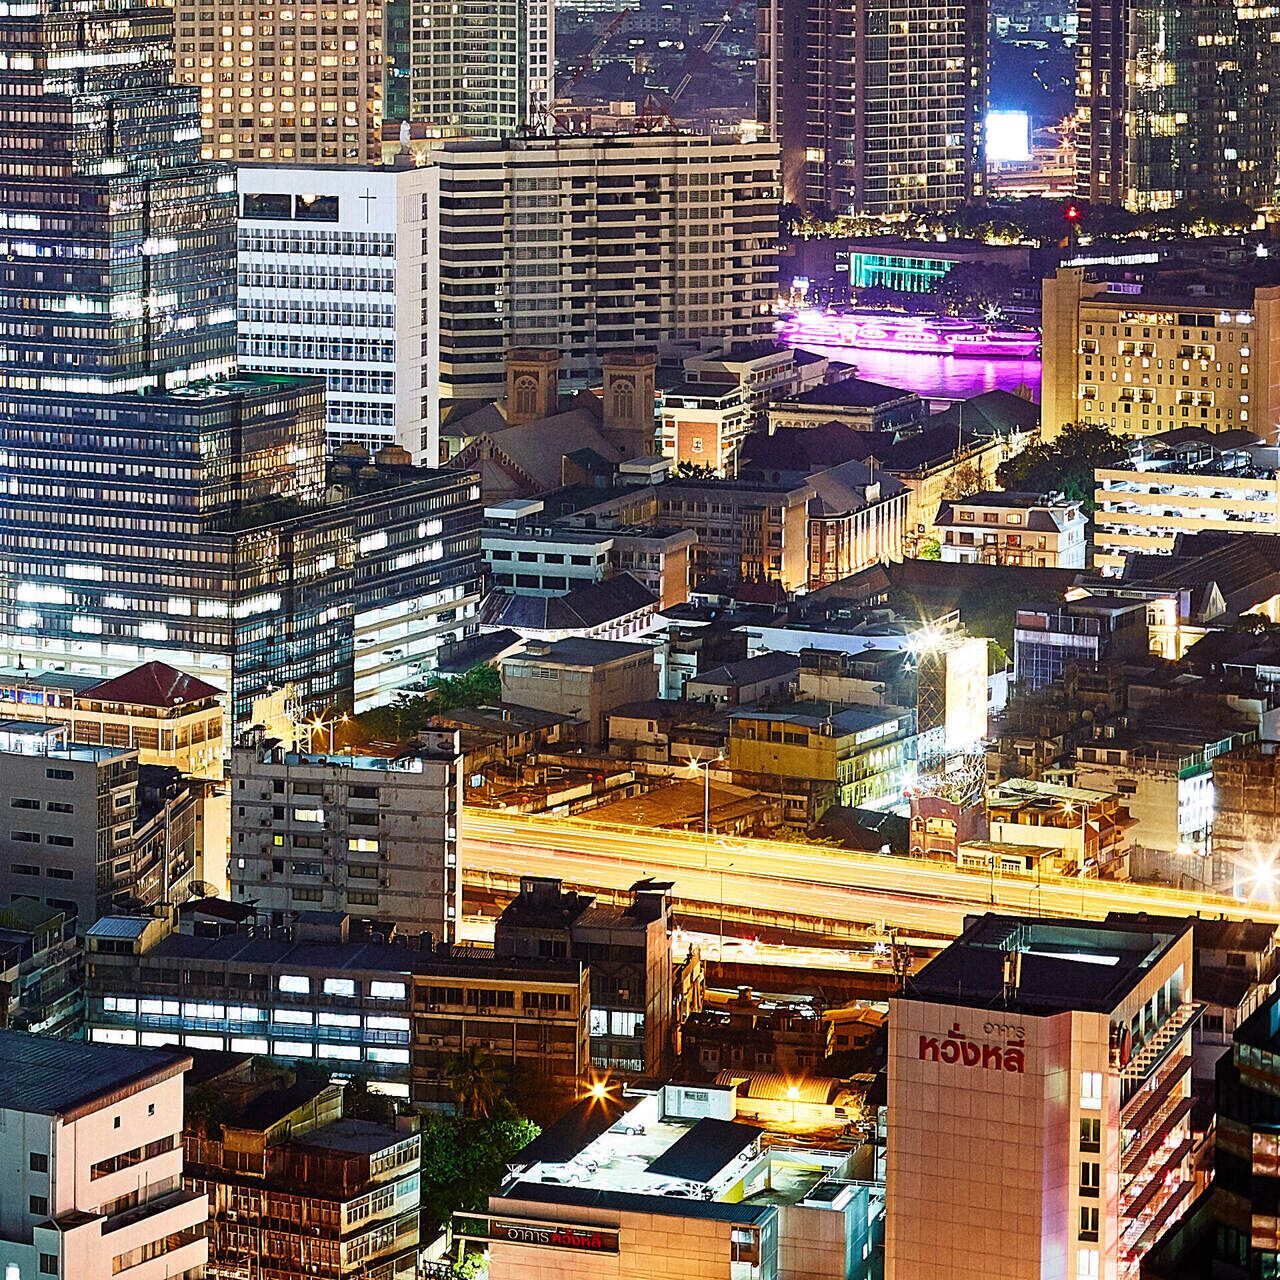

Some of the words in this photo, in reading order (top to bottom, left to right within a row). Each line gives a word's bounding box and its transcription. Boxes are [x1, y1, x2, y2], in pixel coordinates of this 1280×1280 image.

[983, 1022, 1025, 1039] อาคาร
[919, 1022, 1025, 1073] หวั่งหลี
[507, 1228, 549, 1243] อาคาร
